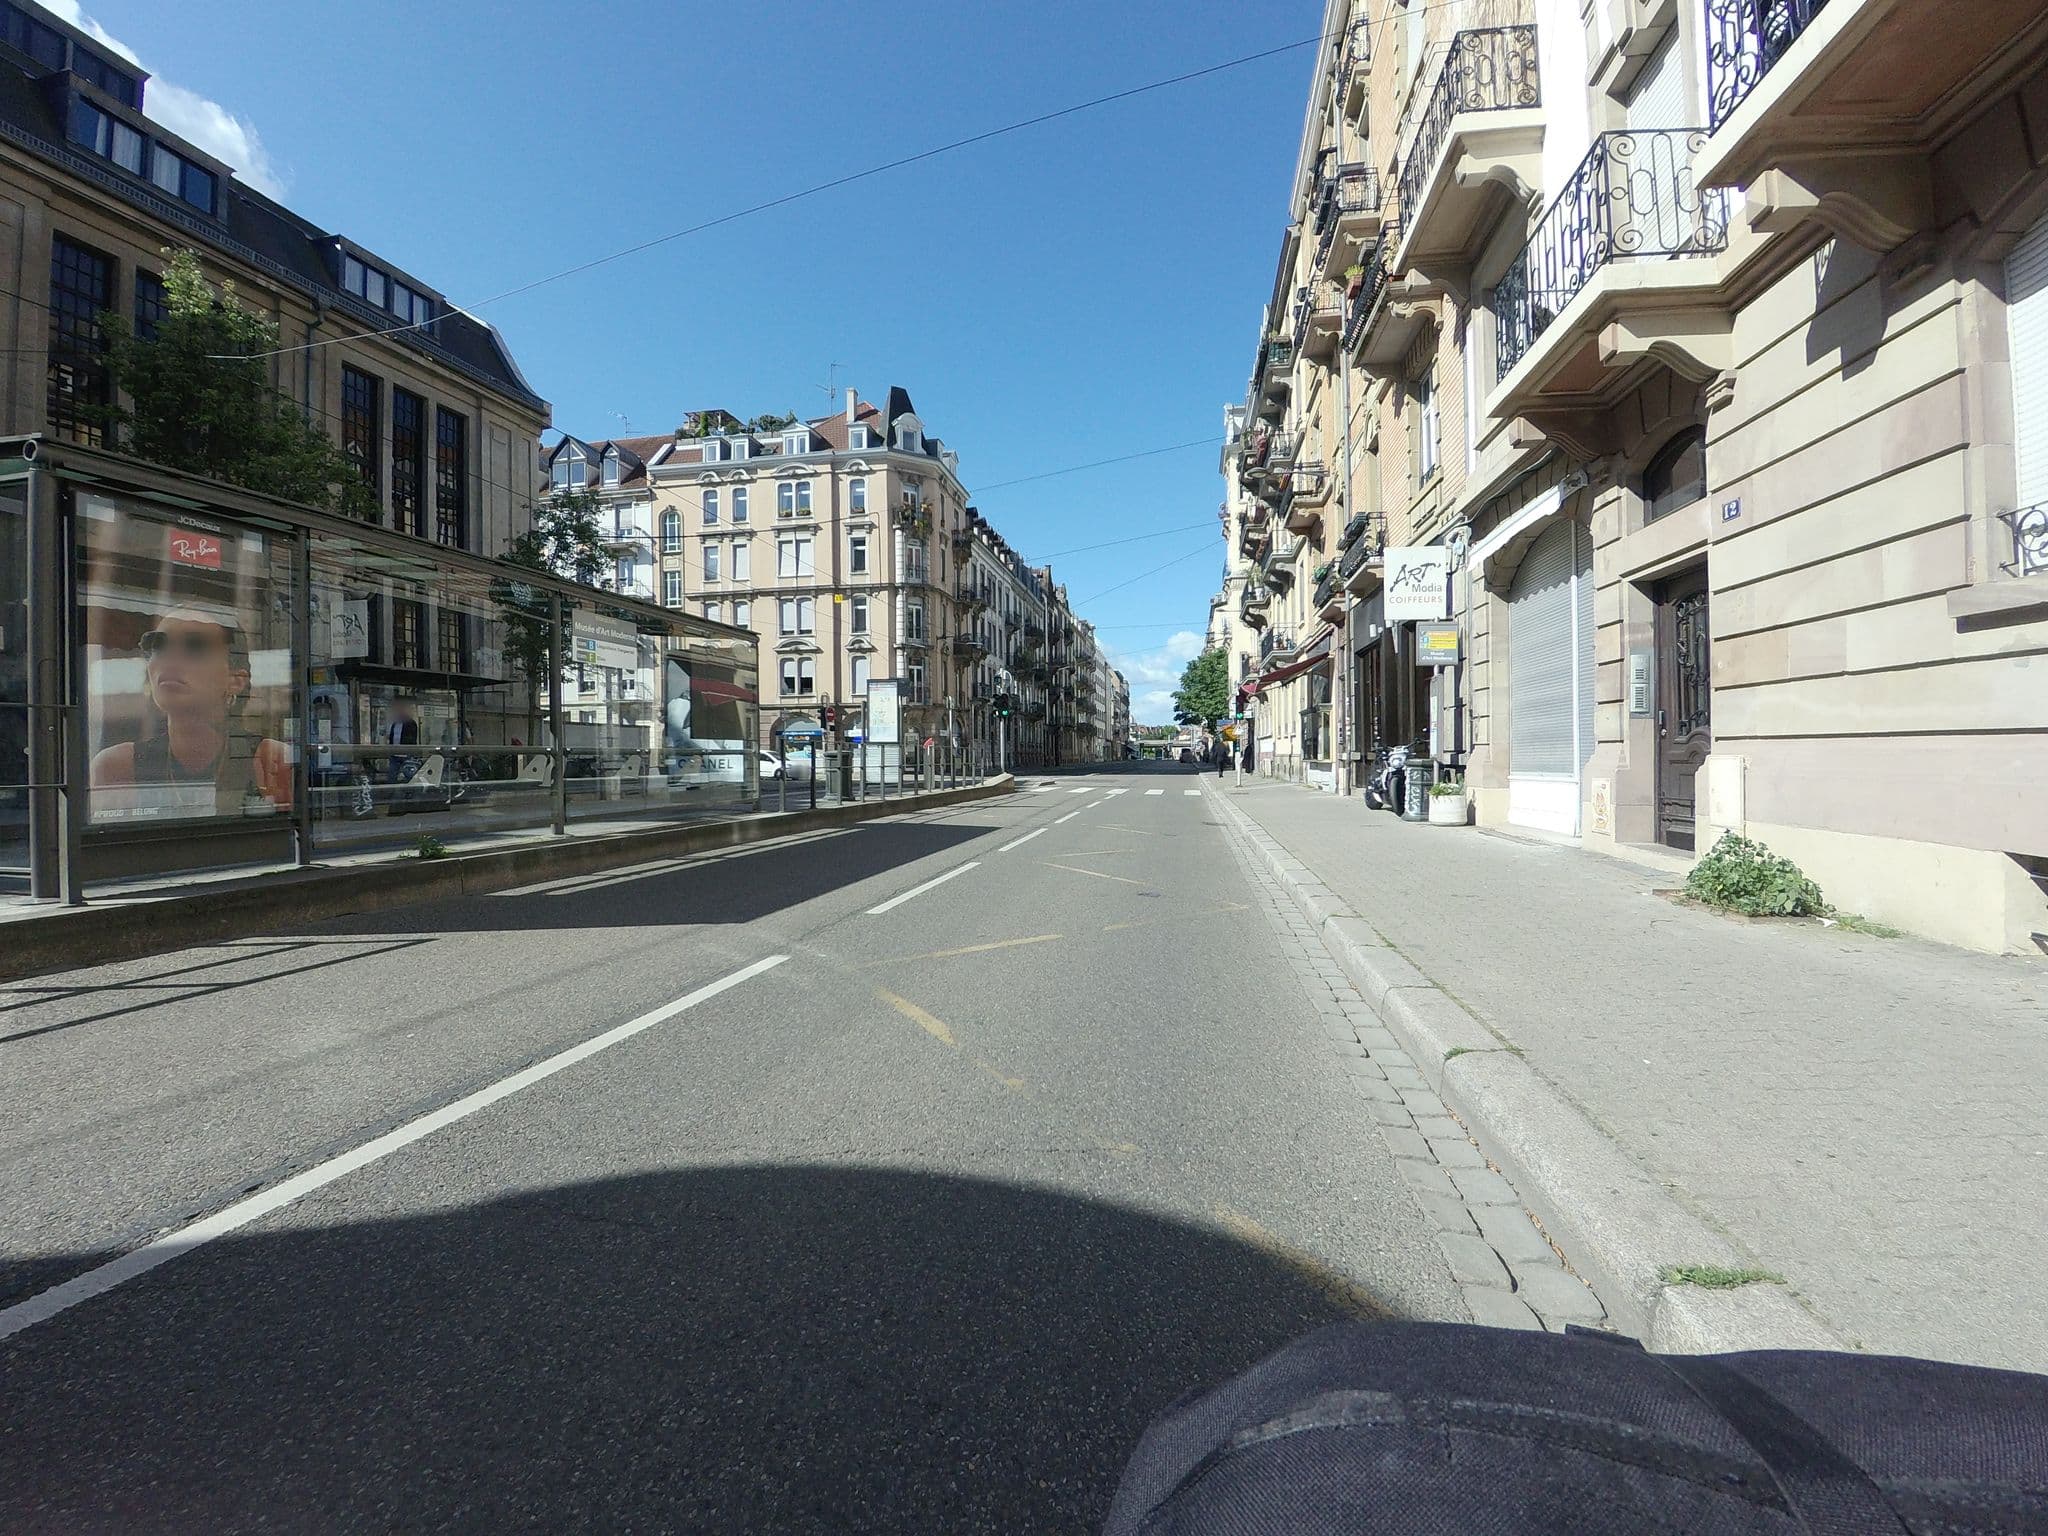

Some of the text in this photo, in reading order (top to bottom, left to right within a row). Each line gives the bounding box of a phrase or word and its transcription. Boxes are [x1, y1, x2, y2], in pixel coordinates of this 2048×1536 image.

[1724, 501, 1737, 518] 12
[172, 538, 218, 560] Ray-Ban
[1411, 583, 1443, 593] Modia
[1388, 595, 1443, 604] COIFFEURS
[677, 758, 734, 769] CANEL
